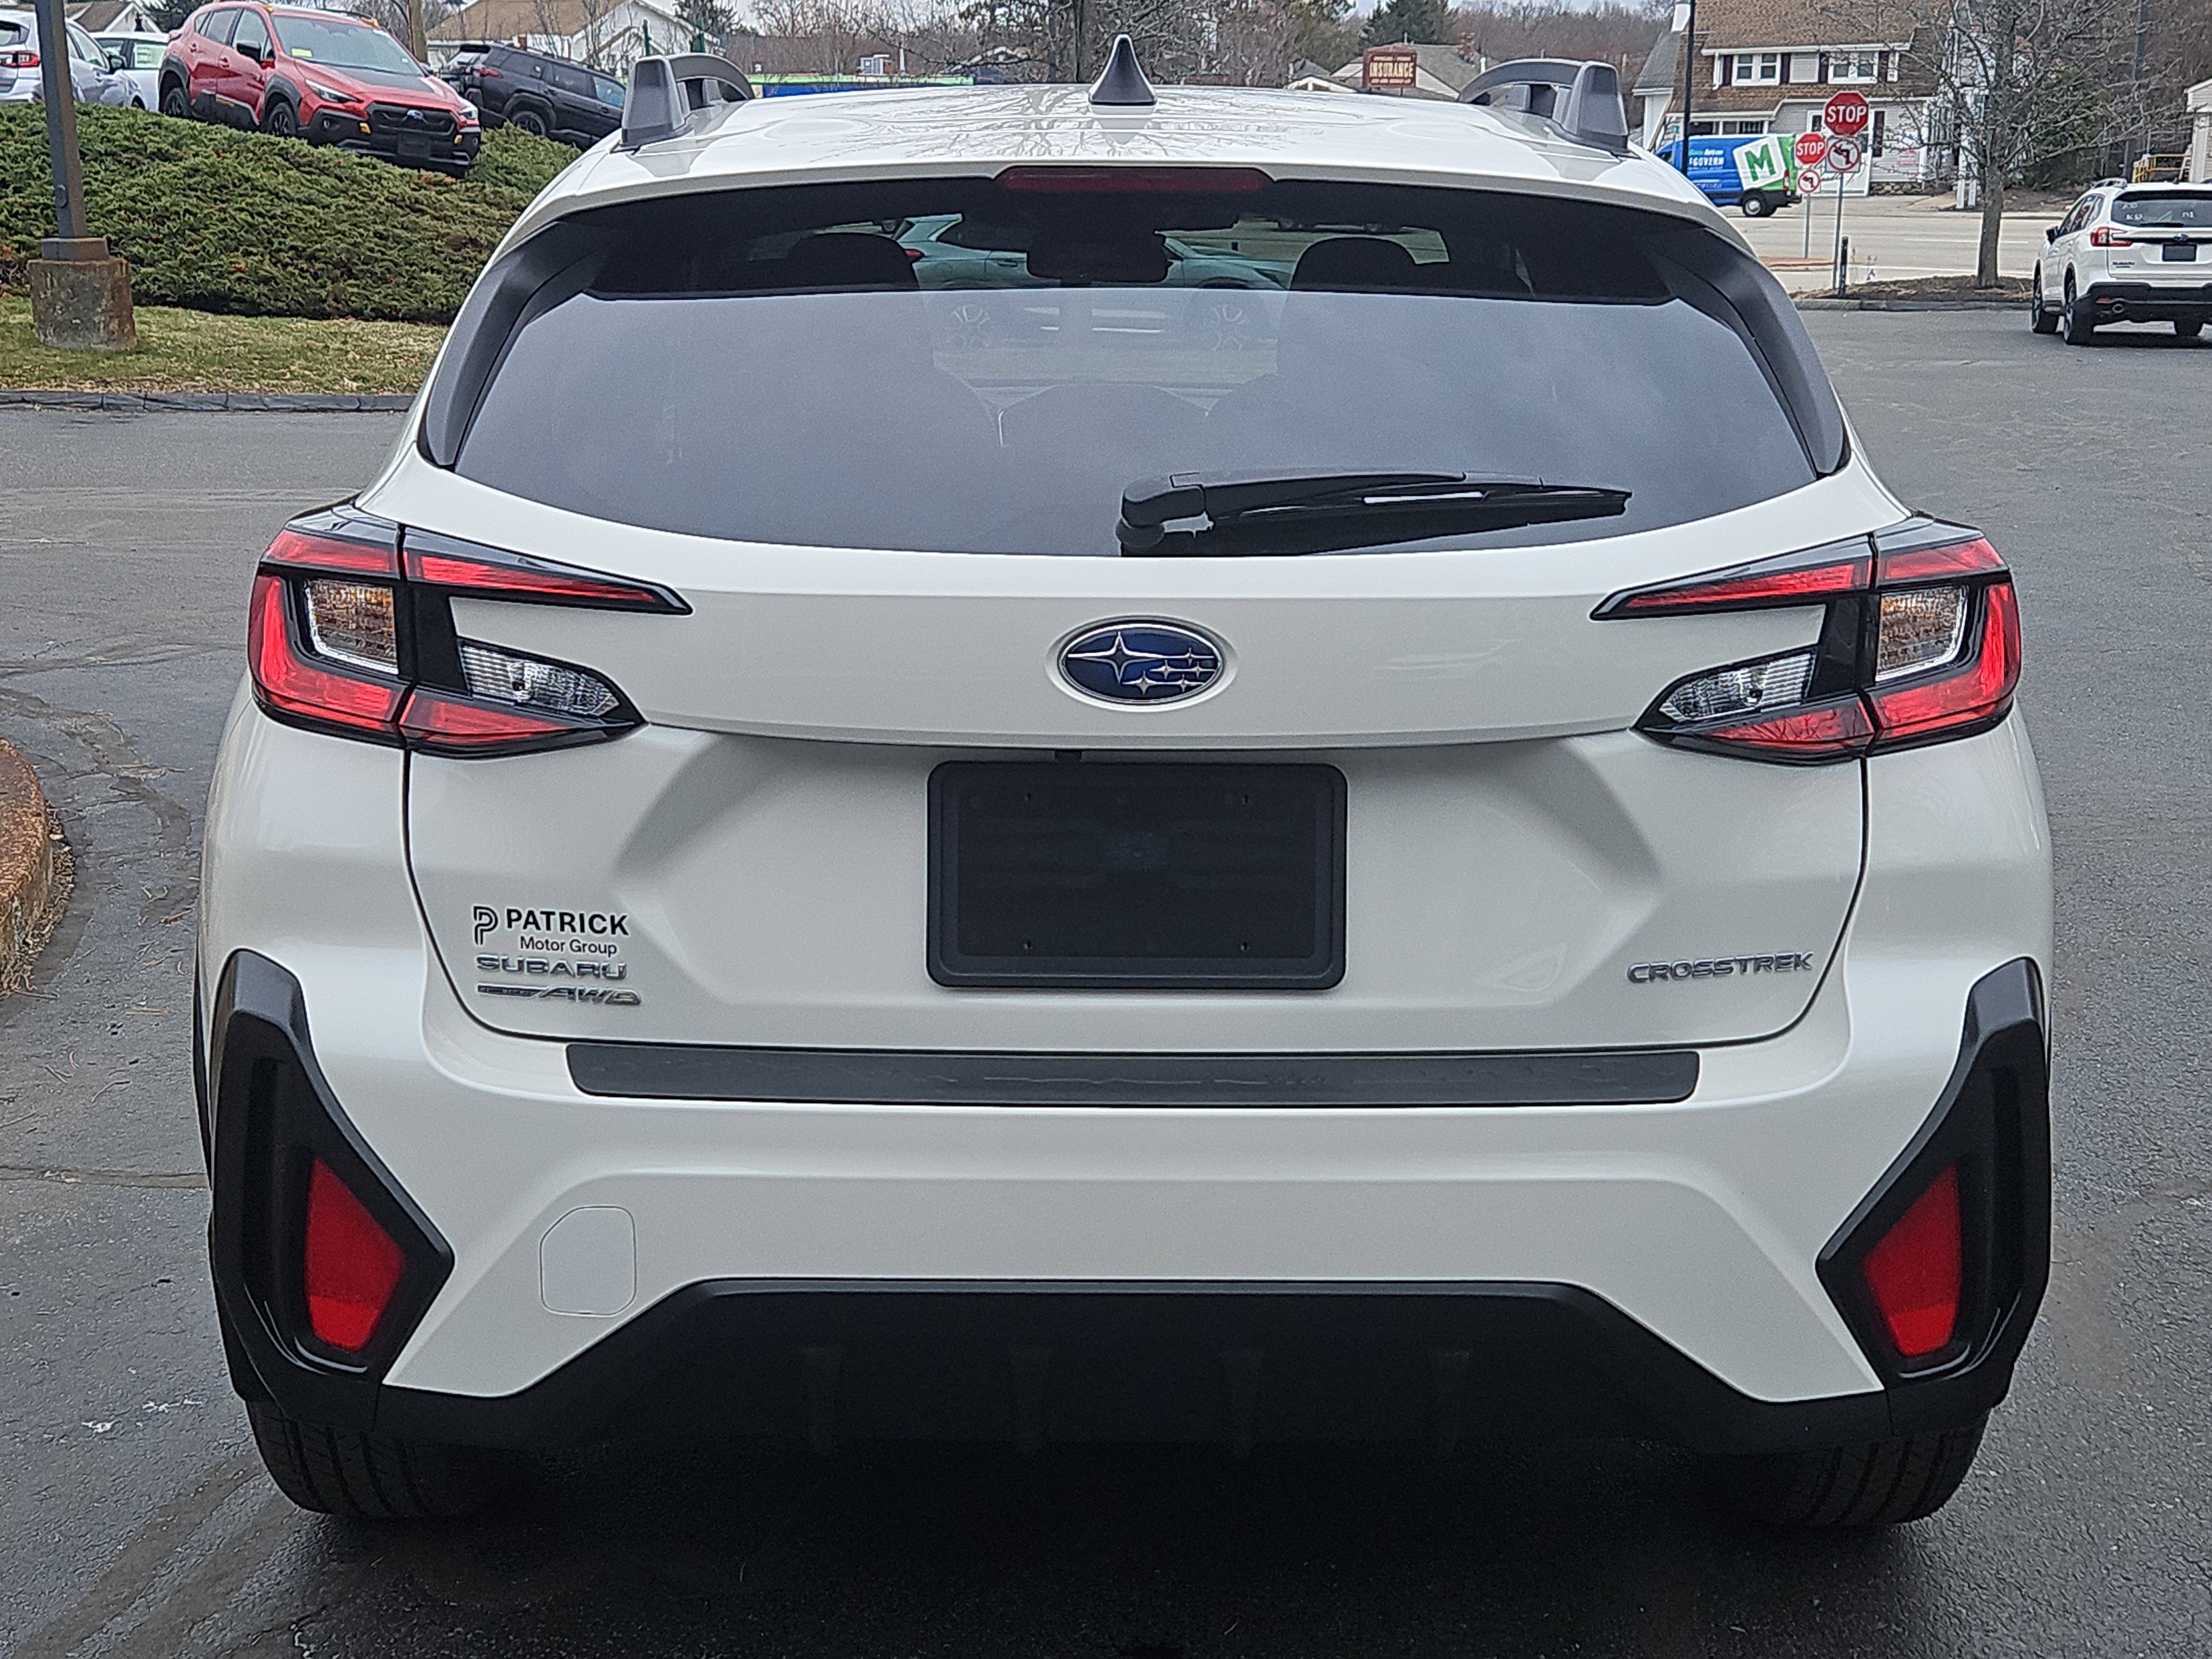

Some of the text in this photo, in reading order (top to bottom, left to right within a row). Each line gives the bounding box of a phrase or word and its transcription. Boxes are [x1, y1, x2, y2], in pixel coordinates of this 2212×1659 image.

[1369, 62, 1414, 78] INSURANCE
[1827, 105, 1867, 123] STOP
[1796, 142, 1825, 156] STOP
[1744, 143, 1777, 182] M
[506, 908, 629, 936] PATRICK
[520, 936, 618, 957] Motor Group
[476, 954, 627, 980] SUBARU
[1628, 951, 1815, 983] CROSSTREK
[537, 986, 642, 1006] AWD
